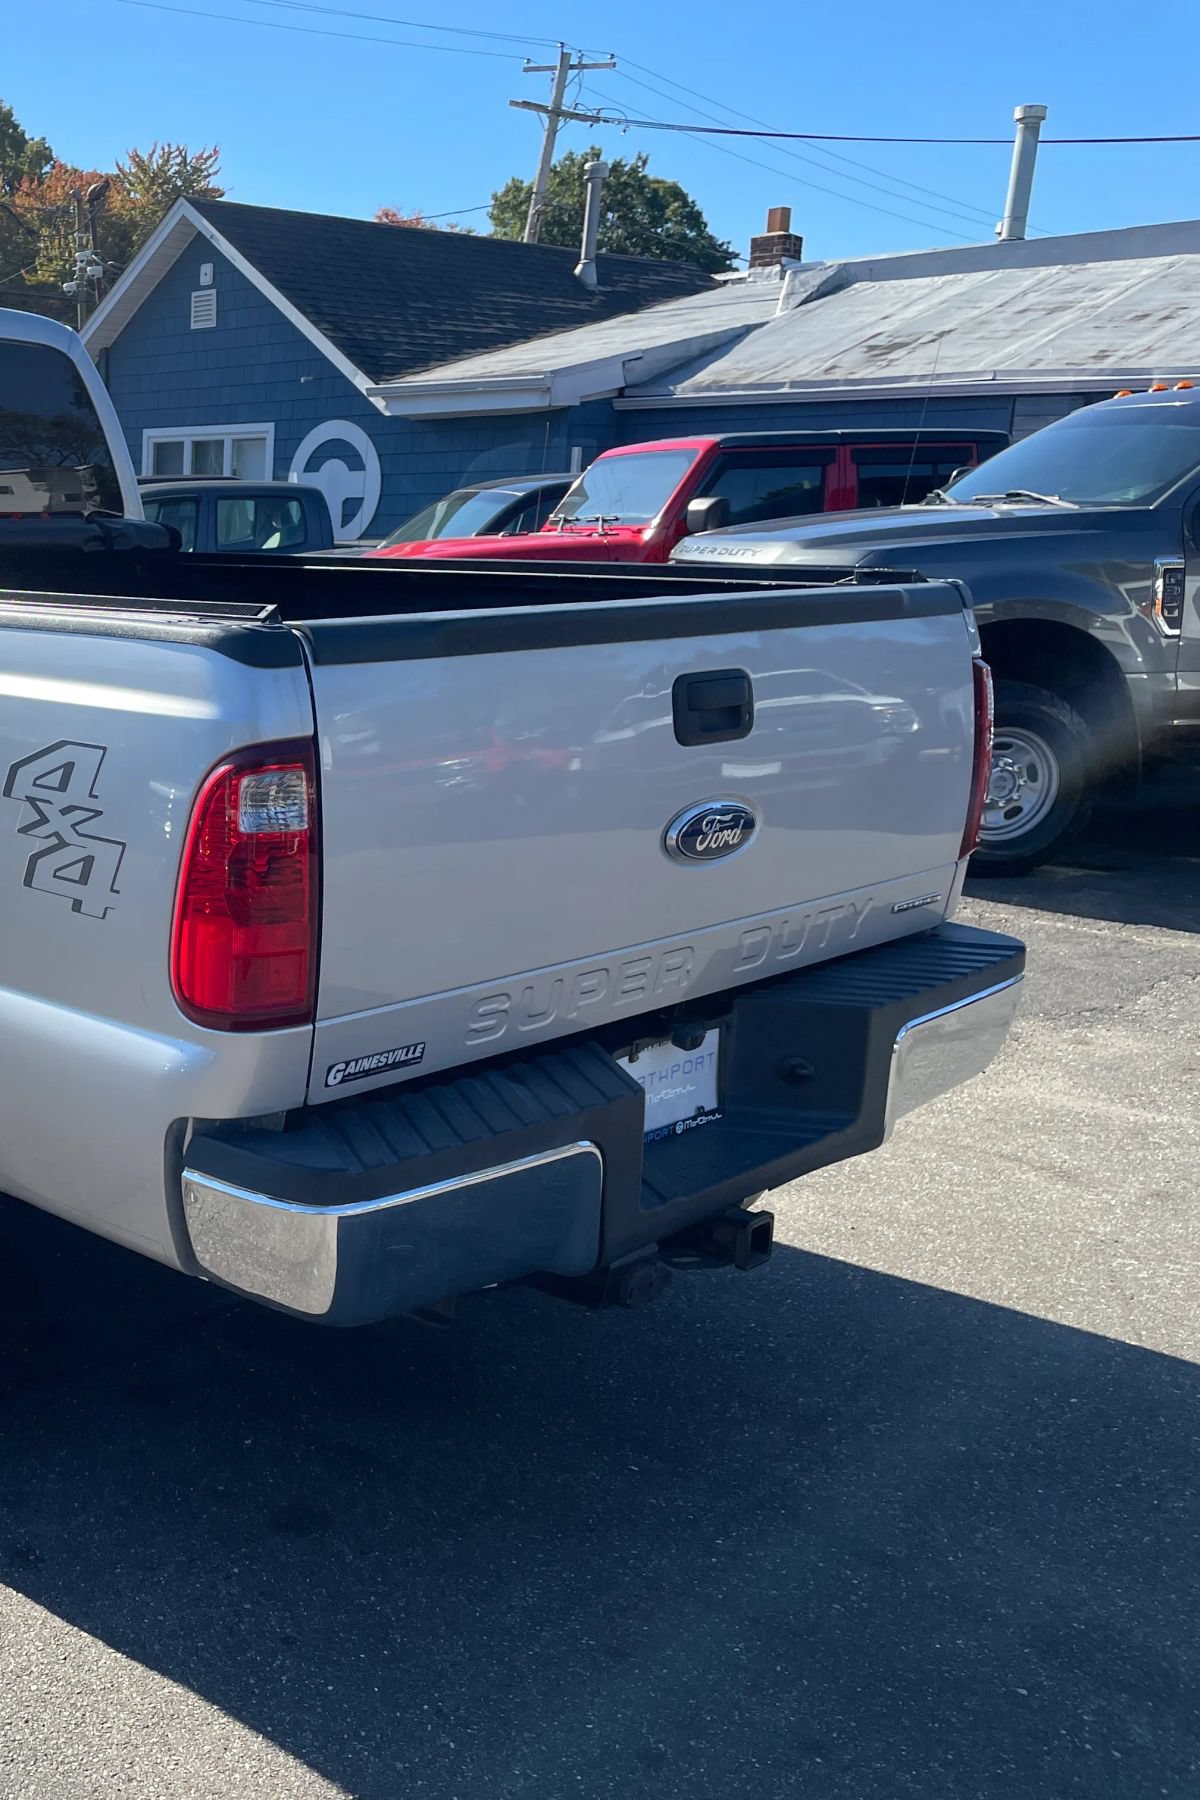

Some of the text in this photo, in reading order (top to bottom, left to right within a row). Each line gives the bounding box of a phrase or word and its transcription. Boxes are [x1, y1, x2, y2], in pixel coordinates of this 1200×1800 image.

[679, 544, 764, 557] SUPER DUTY
[696, 812, 746, 852] Ford
[465, 898, 874, 1046] SUPER DUTY
[637, 1052, 715, 1088] RTHPORT
